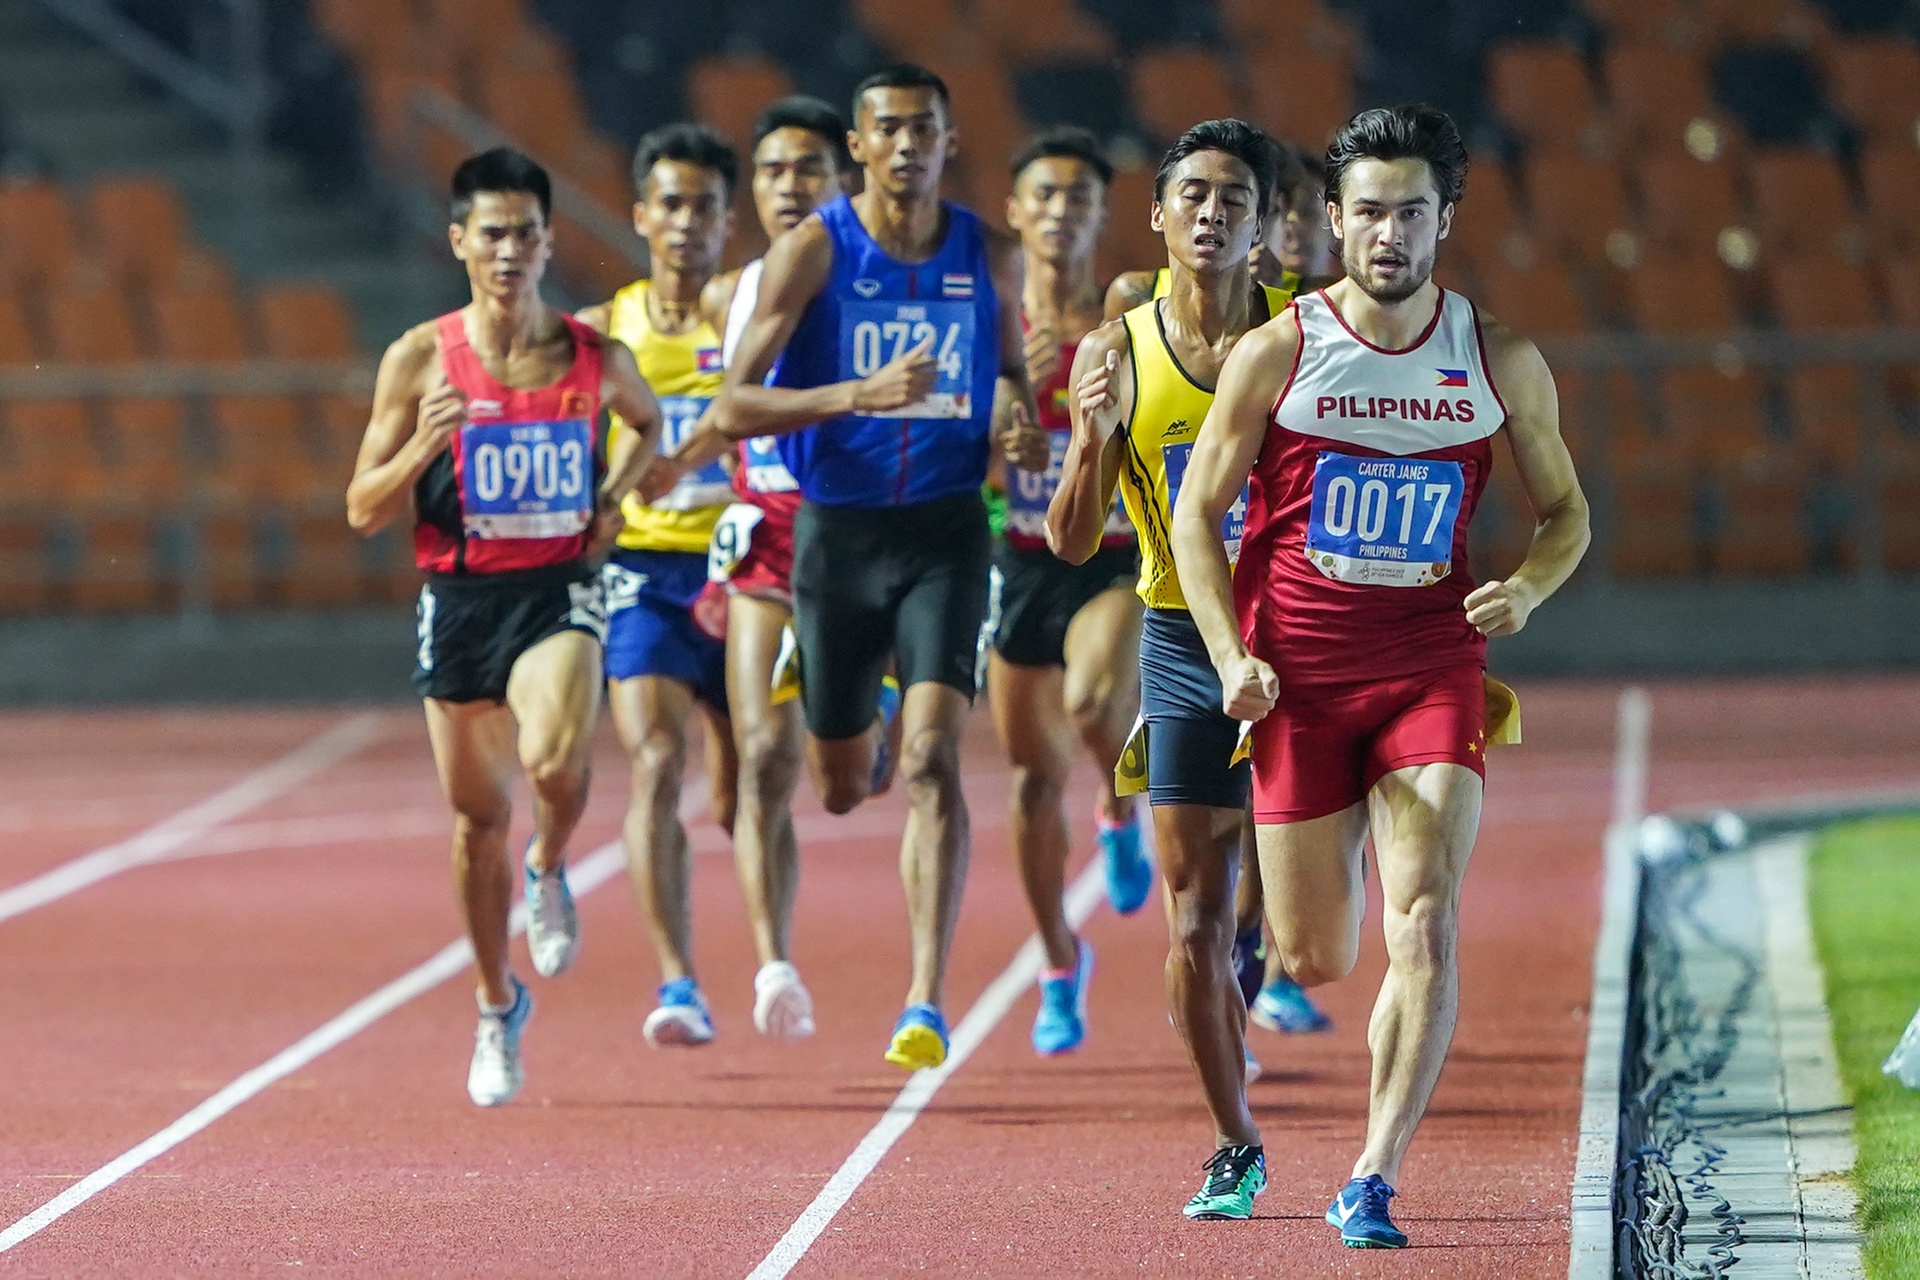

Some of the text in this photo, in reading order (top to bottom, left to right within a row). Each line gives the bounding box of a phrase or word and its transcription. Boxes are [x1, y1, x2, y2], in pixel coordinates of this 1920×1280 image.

[853, 320, 962, 380] 0724
[1316, 396, 1475, 423] PILIPINAS
[474, 439, 583, 501] 0903
[1358, 462, 1429, 480] CARTER JAMES
[1324, 476, 1451, 545] 0017
[1359, 544, 1407, 559] PHILIPPINES
